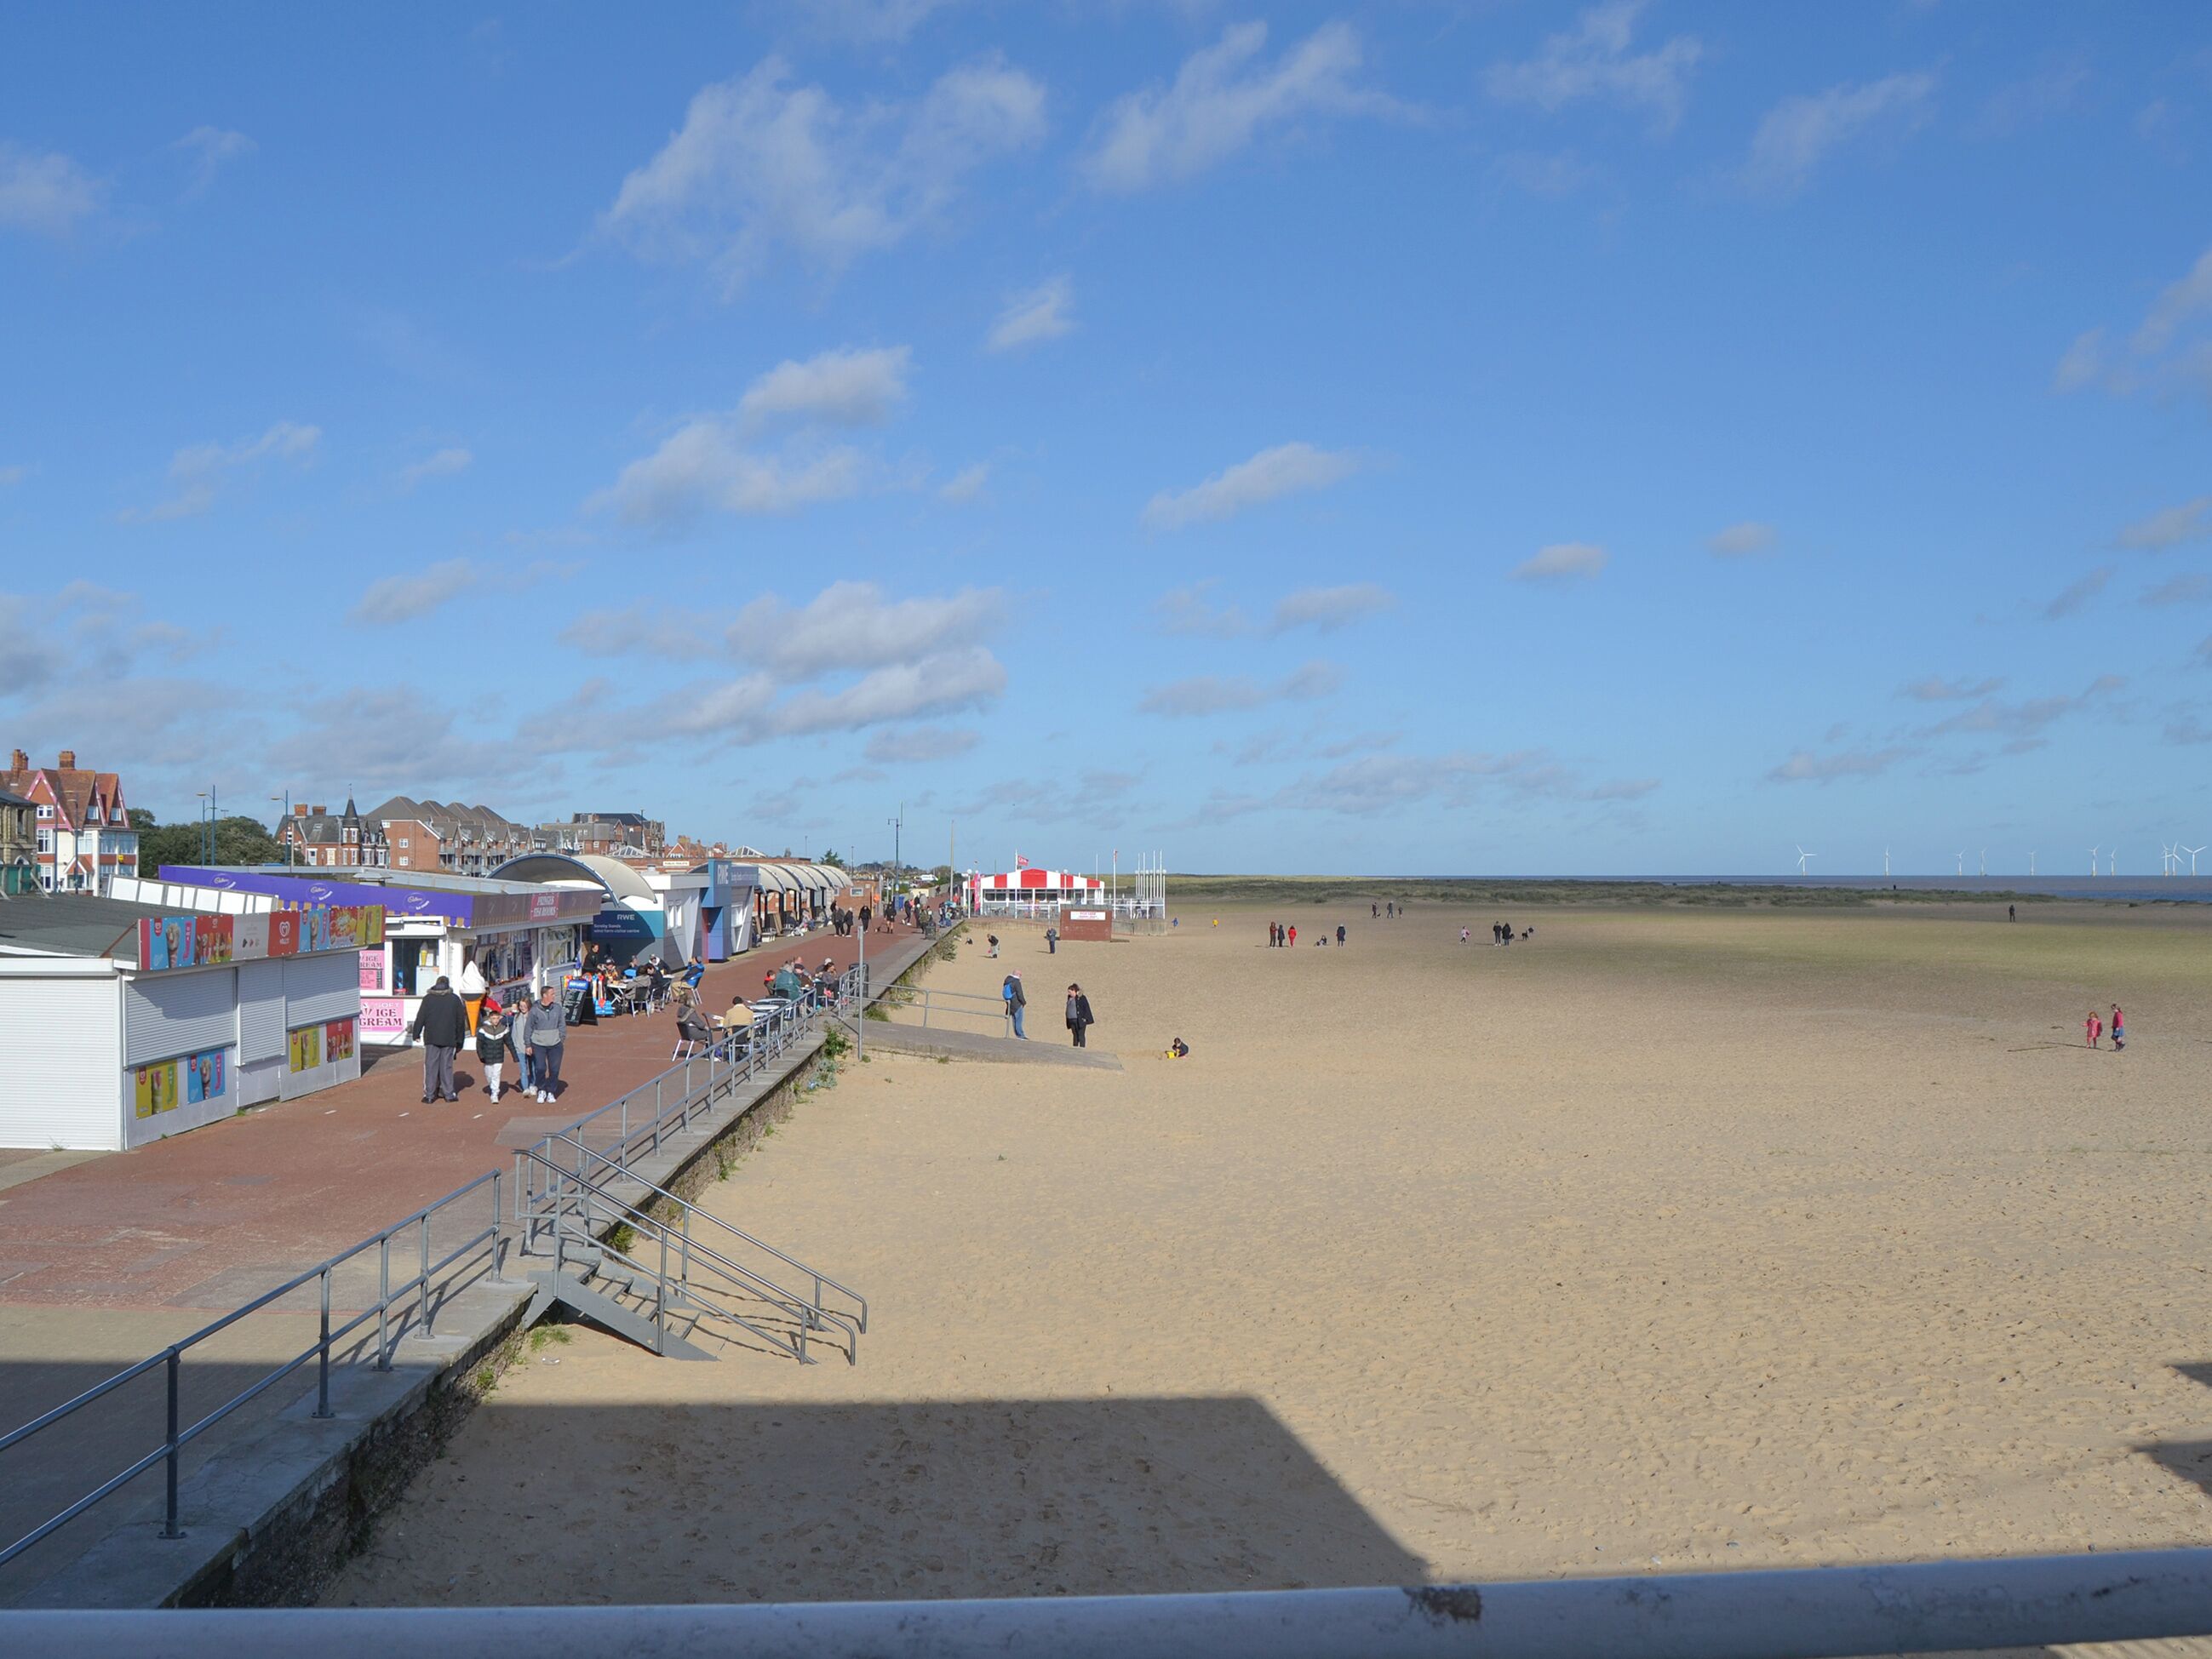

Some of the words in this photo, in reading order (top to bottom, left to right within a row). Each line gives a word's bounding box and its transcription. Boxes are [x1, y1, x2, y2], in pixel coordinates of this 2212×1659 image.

[717, 864, 729, 885] RWE
[375, 1009, 397, 1017] ICE
[359, 1017, 403, 1027] CREAM
